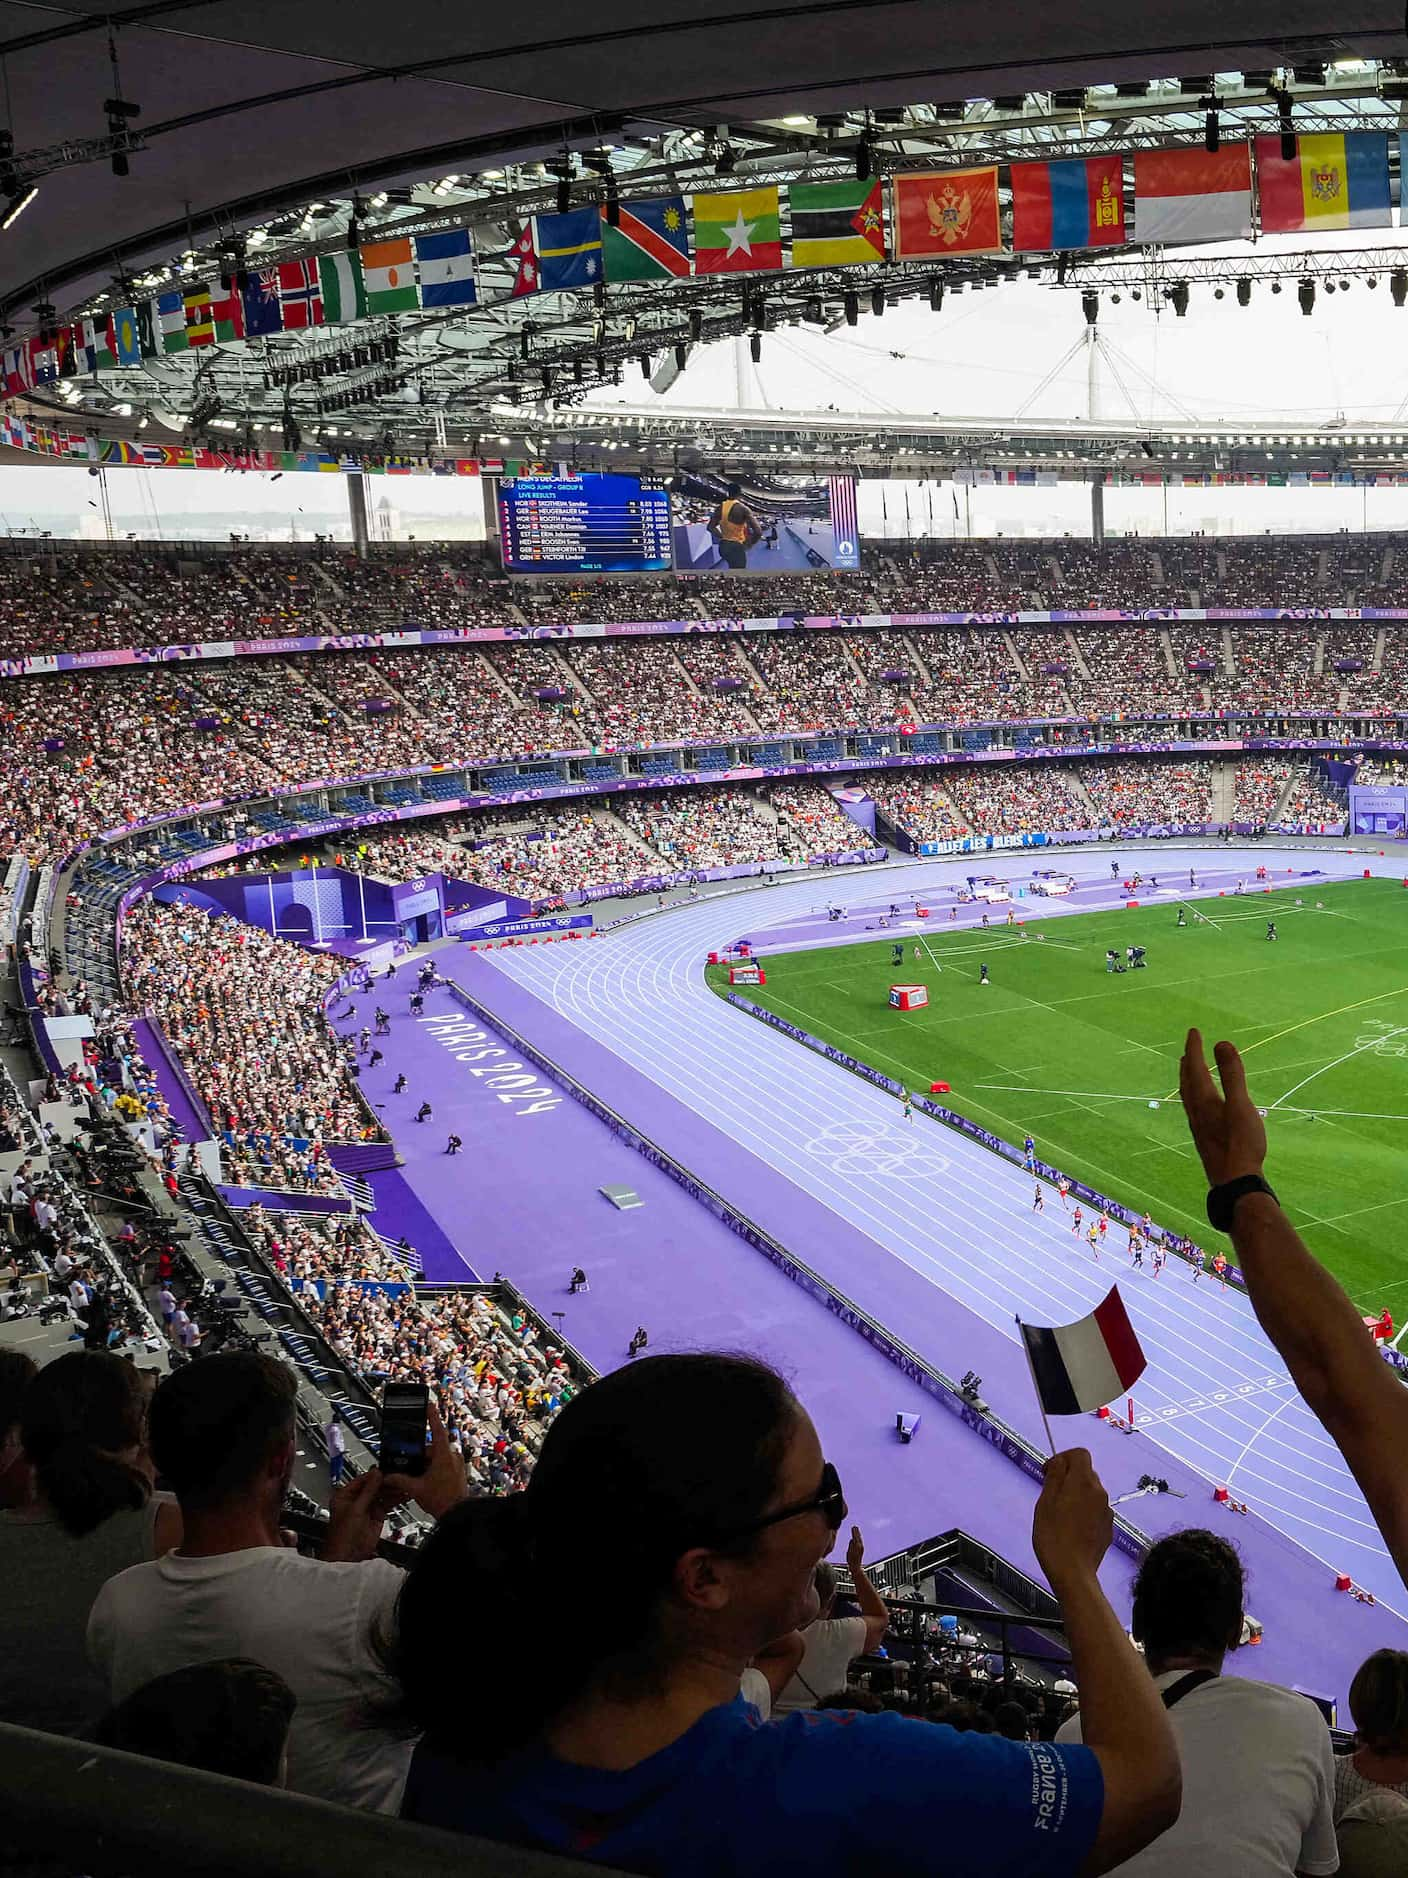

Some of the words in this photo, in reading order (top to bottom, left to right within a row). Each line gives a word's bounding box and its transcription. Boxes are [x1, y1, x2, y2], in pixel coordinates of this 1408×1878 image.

[308, 825, 326, 833] PARIS
[505, 924, 528, 933] PARIS
[531, 921, 552, 929] 2024
[416, 1013, 506, 1061] PARIS
[470, 1062, 562, 1115] 2024
